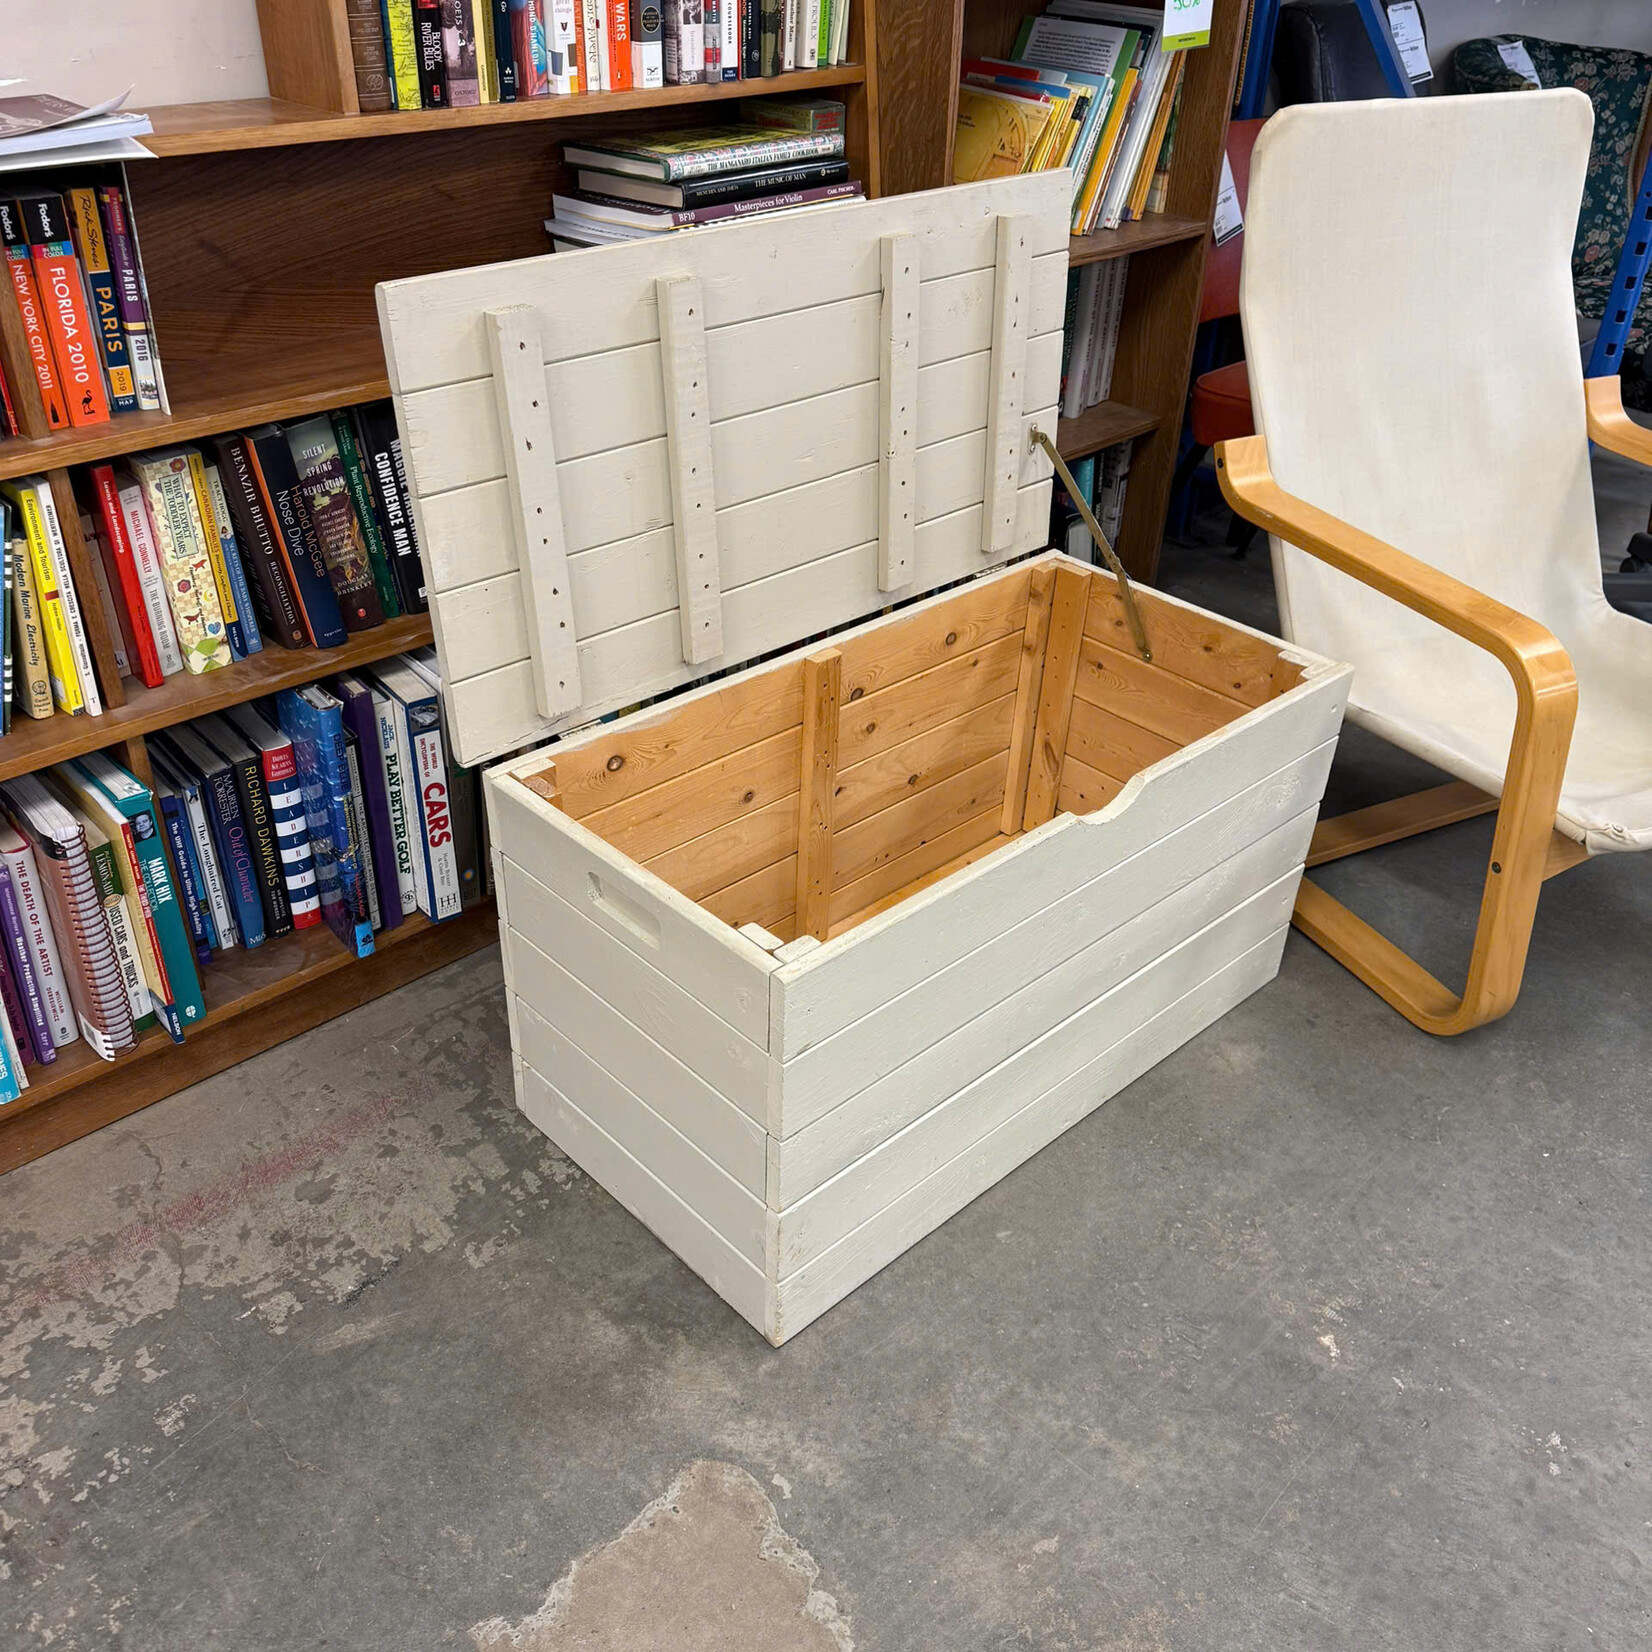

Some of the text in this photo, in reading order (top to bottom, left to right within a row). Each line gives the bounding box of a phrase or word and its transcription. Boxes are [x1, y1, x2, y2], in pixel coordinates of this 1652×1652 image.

[454, 0, 464, 26] OETS
[528, 0, 536, 23] MOND
[616, 2, 626, 41] WARS
[421, 22, 434, 71] RIVER BLUES
[432, 32, 443, 62] BLOODY
[708, 162, 718, 172] THE
[752, 154, 772, 164] ITALIAN
[774, 152, 792, 162] FAMILY
[792, 149, 818, 159] COOKBOOK
[755, 178, 767, 188] THE
[768, 176, 784, 186] MUSIC
[794, 172, 807, 182] MAN
[38, 203, 54, 238] Fodor's
[678, 212, 696, 222] BF10
[734, 194, 803, 213] Masterpieces for Violin
[0, 205, 16, 240] Fodor's
[122, 269, 138, 302] PARIS
[13, 264, 53, 389] NEW YORK CITY 2011
[50, 267, 88, 383] FLORIDA 2010
[96, 286, 122, 352] PARIS
[135, 338, 148, 362] 2016
[116, 371, 127, 392] 2019
[302, 444, 326, 460] SILENT
[306, 460, 332, 478] SPRING
[390, 438, 407, 488] MAGGIE
[214, 480, 228, 522] TRACY HOGG
[230, 447, 274, 556] BENAZIR BHUTTO
[302, 476, 345, 497] REVOLUTION
[374, 452, 404, 526] CONFIDENCE
[393, 528, 412, 556] MAN
[164, 480, 186, 554] THE TODDLER YEARS
[172, 478, 192, 539] WHAT TO EXPECT
[201, 489, 213, 521] CANADIAN
[208, 520, 219, 553] FAMILIES
[276, 490, 304, 557] Nose Dive
[350, 466, 359, 484] Plant
[356, 485, 370, 528] Reproductive
[366, 528, 378, 554] Ecology
[26, 498, 50, 581] Environment and Tourism
[108, 502, 116, 515] and
[112, 515, 124, 554] Landscaping
[130, 510, 152, 574] MICHAEL CONNELLY
[291, 484, 312, 530] Harold
[304, 530, 325, 578] McGee
[270, 561, 296, 625] RECONCILIATION
[337, 573, 368, 588] DOUGLAS
[337, 580, 372, 596] BRINKLEY
[14, 554, 40, 666] Modern Marine Electricity
[150, 589, 171, 650] THE BURNING ROOM
[380, 717, 390, 750] NICKLAUS
[387, 724, 395, 742] JACK
[214, 777, 231, 825] FORRESTER
[223, 774, 240, 819] MAUREEN
[386, 753, 411, 874] PLAY BETTER GOLF
[244, 766, 280, 886] RICHARD DAWKINS
[424, 782, 451, 848] CARS
[174, 835, 182, 848] UHF
[229, 826, 244, 849] Out
[148, 857, 168, 887] MARK
[178, 848, 187, 870] Guide
[183, 870, 188, 878] to
[198, 822, 223, 910] The Longhaired Cat
[140, 860, 158, 912] THE COLLECTION
[156, 884, 172, 904] HIX
[236, 858, 254, 903] Character
[16, 860, 54, 977] THE DEATH OF THE ARTIST
[109, 906, 123, 926] USED
[188, 895, 197, 913] High
[114, 926, 128, 946] CARS
[192, 912, 202, 935] Fidelity
[120, 946, 132, 960] and
[16, 936, 27, 963] Weather
[23, 963, 36, 996] Predicting
[32, 997, 44, 1026] Simplified
[40, 1032, 48, 1046] Carr
[123, 960, 139, 988] TRUCKS
[55, 990, 64, 1014] WILLIAM
[172, 1012, 181, 1036] NELSON
